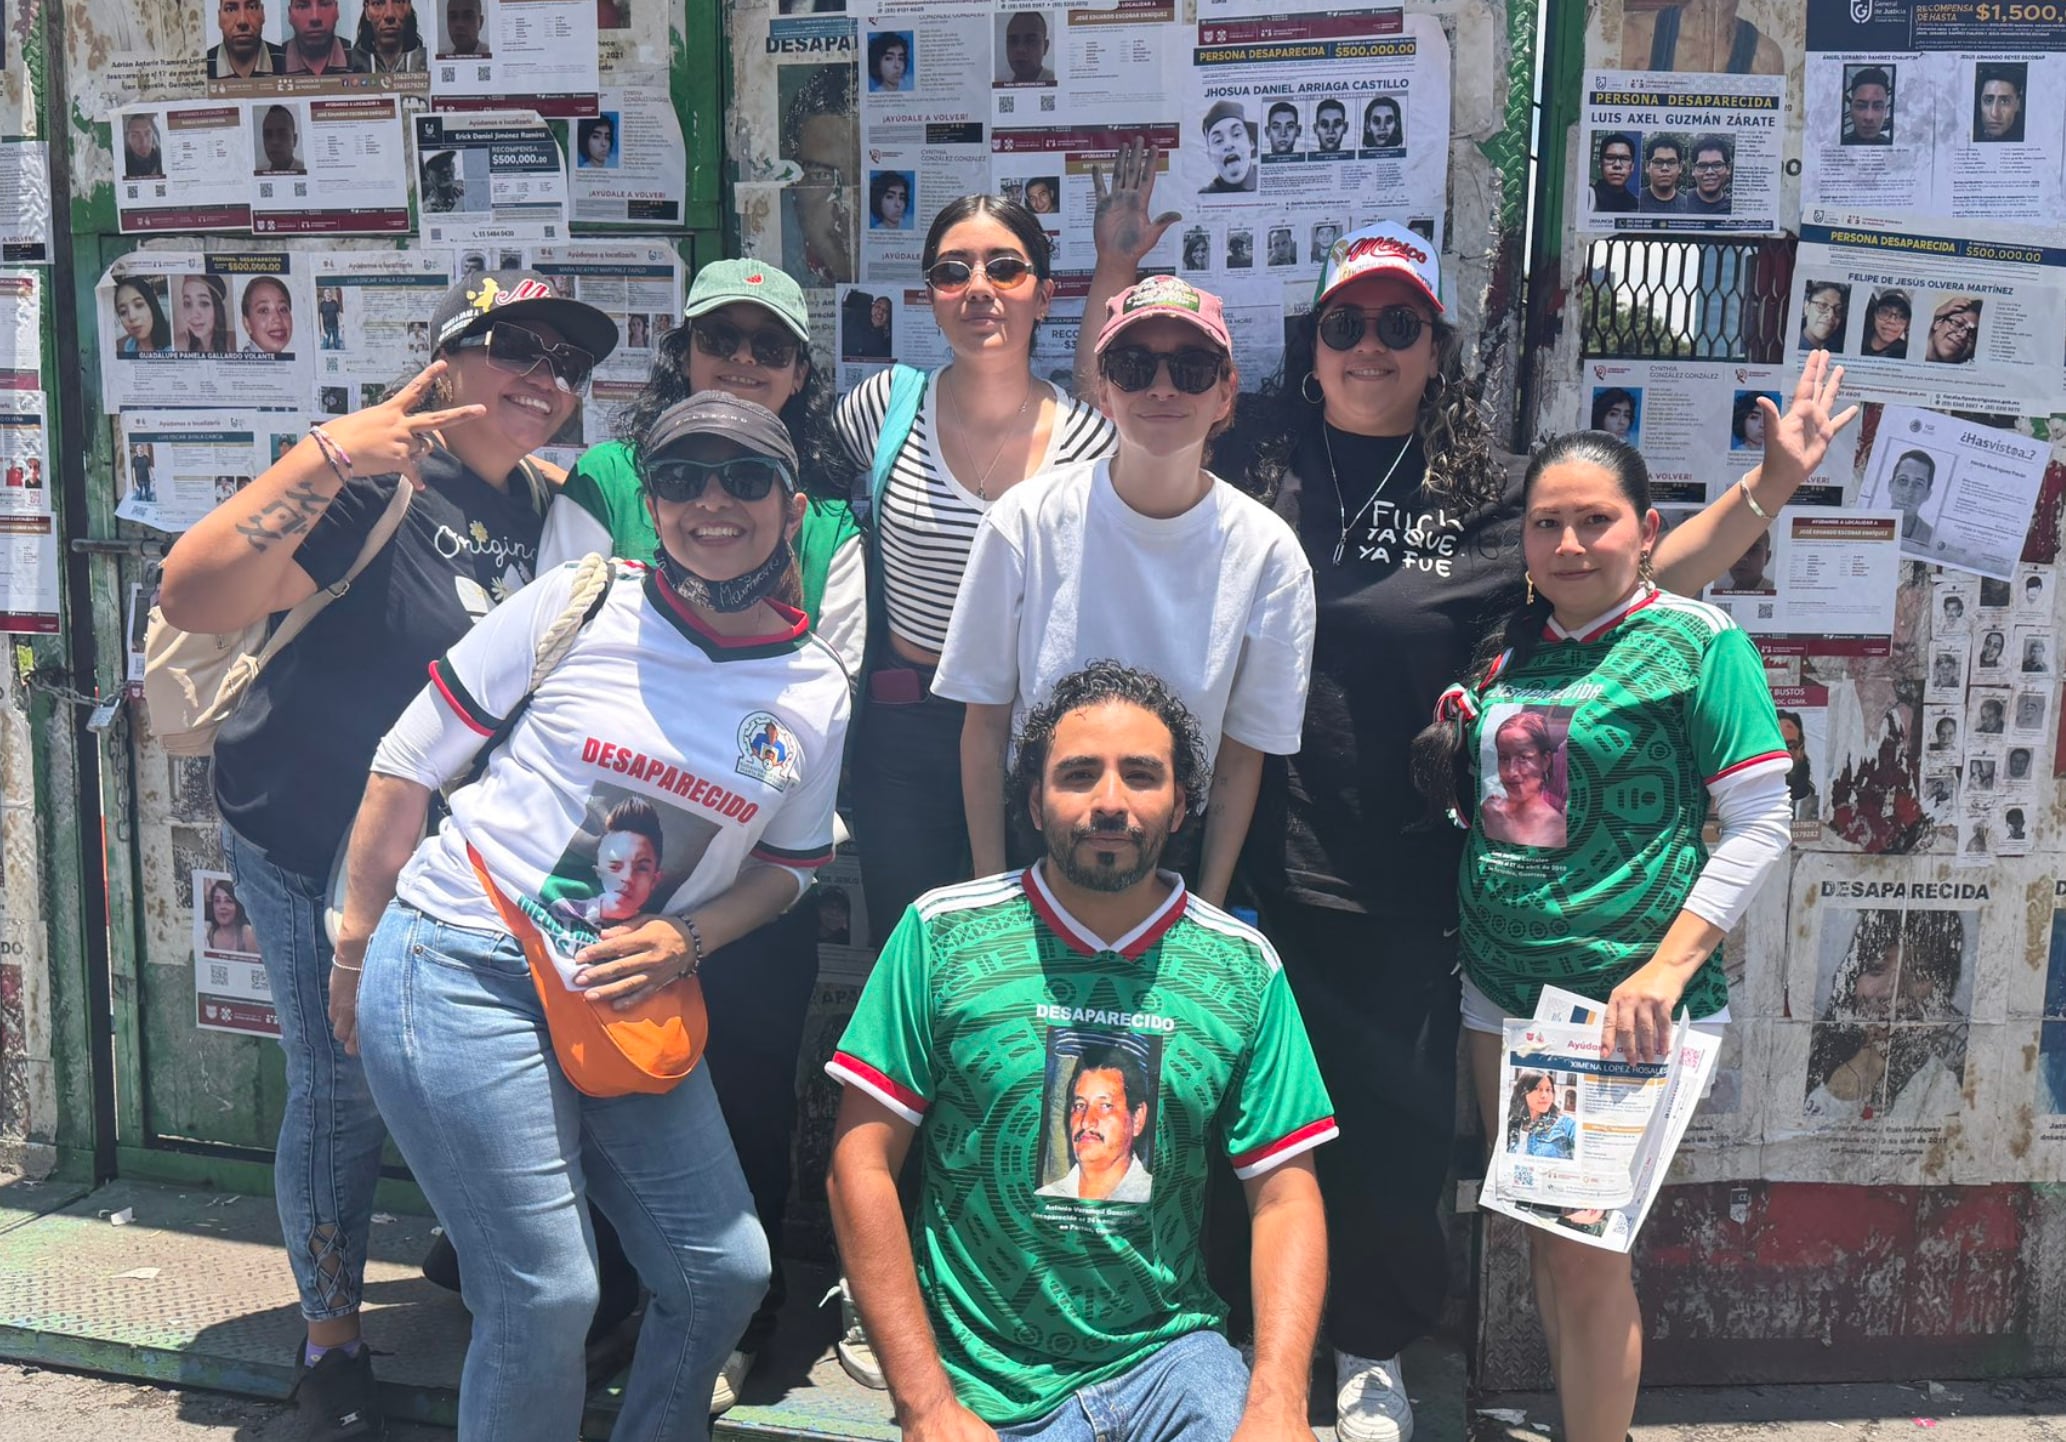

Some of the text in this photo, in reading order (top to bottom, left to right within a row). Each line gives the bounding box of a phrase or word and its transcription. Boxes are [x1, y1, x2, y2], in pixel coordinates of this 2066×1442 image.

[1916, 4, 1973, 13] RECOMPENSA
[1917, 13, 1957, 22] DE HASTA
[766, 37, 858, 54] DESAPA
[1200, 43, 1416, 62] PERSONA DESAPARECIDA $500,000.00
[606, 51, 624, 59] 2021
[1204, 86, 1250, 98] JHOSUA
[1253, 84, 1295, 96] DANIEL
[1298, 81, 1350, 93] ARRIAGA
[1352, 78, 1410, 91] CASTILLO
[1596, 93, 1772, 108] PERSONA DESAPARECIDA
[933, 113, 969, 121] VOLVER!
[1591, 111, 1776, 127] LUIS AXEL GUZMÁN ZÁRATE
[473, 131, 494, 139] Daniel
[491, 145, 538, 153] RECOMPENSA
[1345, 236, 1428, 264] México
[1831, 231, 1878, 245] PERSONA
[1881, 236, 1955, 253] DESAPARECIDA
[1848, 272, 2014, 296] FELIPE DE JESÚS OLVERA MARTÍNEZ
[1656, 473, 1693, 481] VOLVER!
[1403, 528, 1457, 556] QUE
[1358, 545, 1453, 577] YA FUE
[1774, 688, 1806, 697] BUSTOS
[581, 736, 760, 825] DESAPARECIDO
[1821, 880, 1990, 900] DESAPARECIDA
[1036, 1004, 1175, 1031] DESAPARECIDO
[1570, 1061, 1601, 1072] XIMENA
